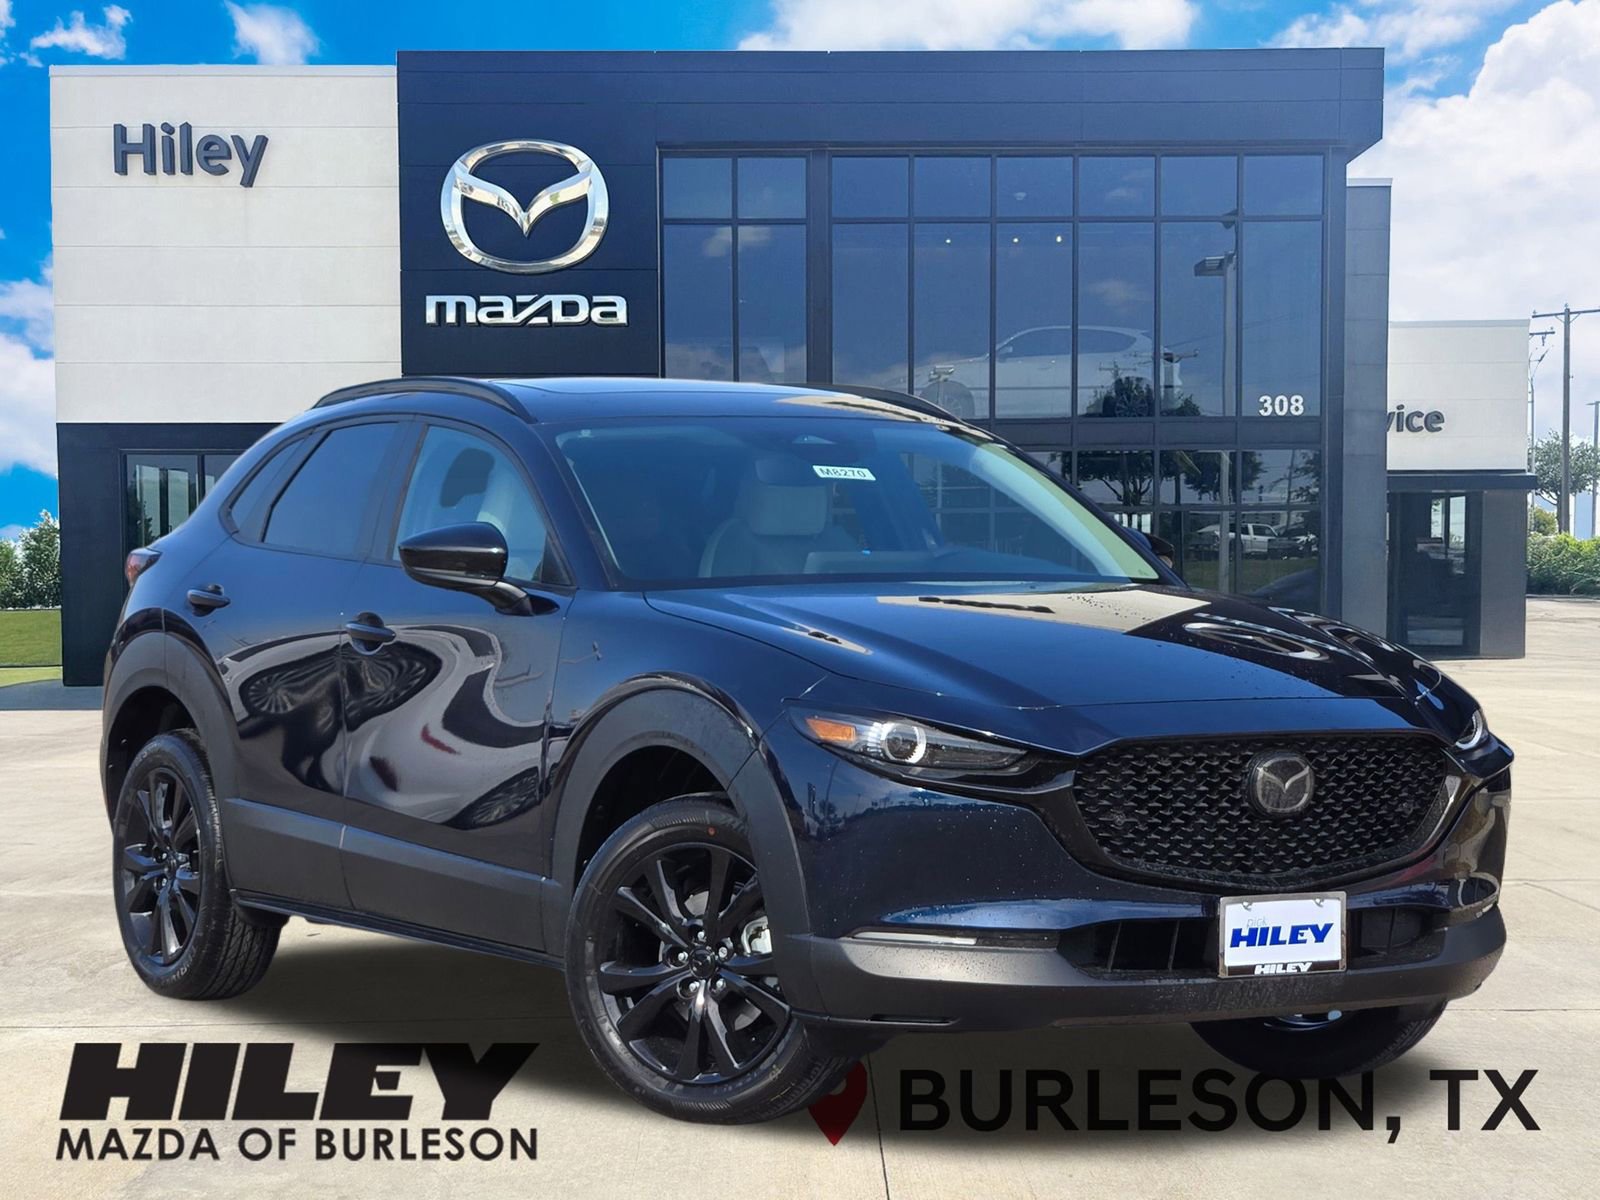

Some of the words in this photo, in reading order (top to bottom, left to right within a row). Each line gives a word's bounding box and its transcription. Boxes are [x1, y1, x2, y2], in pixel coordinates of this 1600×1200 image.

[113, 121, 269, 188] Hiley
[1258, 394, 1305, 417] 308
[818, 466, 868, 479] M8270
[1230, 922, 1334, 948] HILEY
[1254, 961, 1313, 975] HILEY
